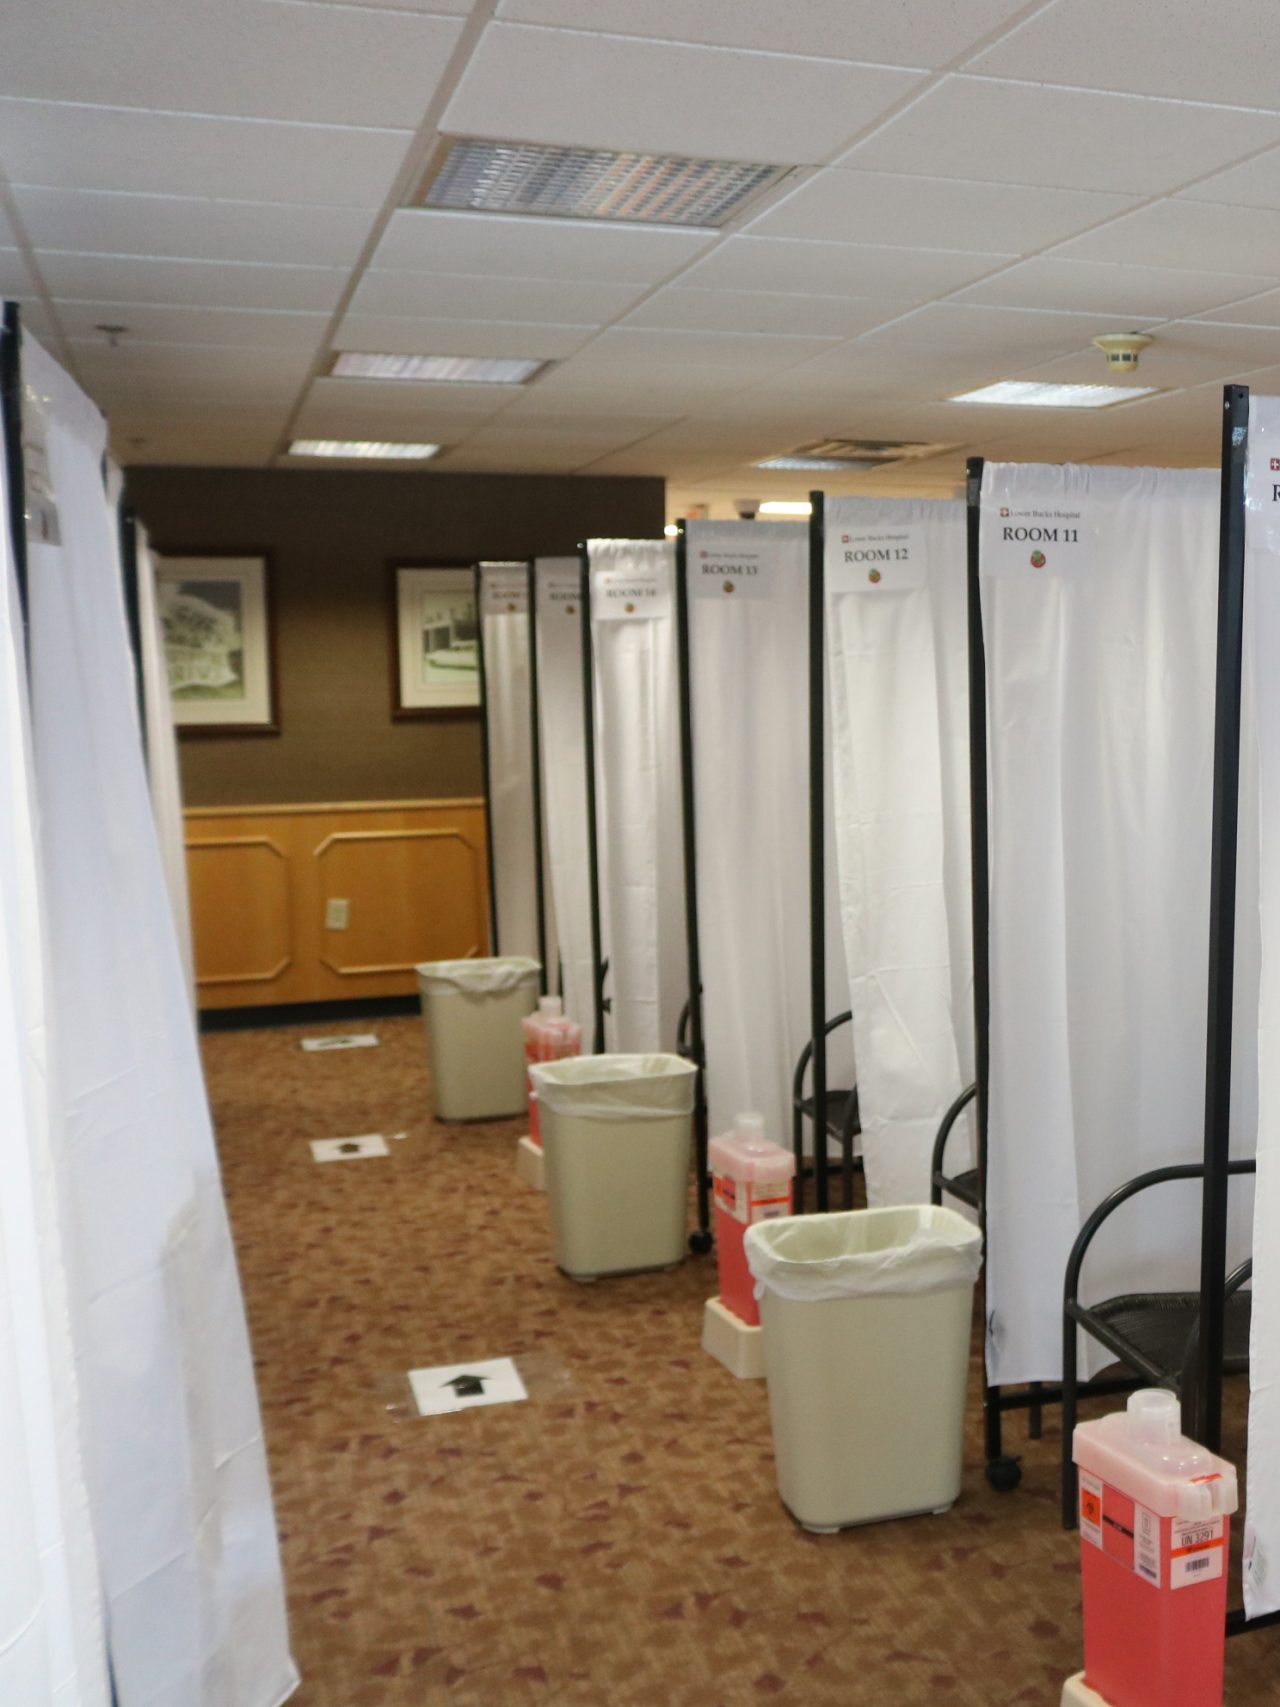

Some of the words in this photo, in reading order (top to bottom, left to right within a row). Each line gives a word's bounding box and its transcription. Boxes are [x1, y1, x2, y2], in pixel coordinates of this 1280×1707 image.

[1003, 527, 1058, 542] ROOM
[1063, 529, 1078, 542] 11
[844, 549, 890, 563] ROOM
[893, 548, 909, 561] 12
[702, 564, 743, 576] ROOM
[1181, 1535, 1193, 1547] UN
[1194, 1529, 1214, 1544] 3291
